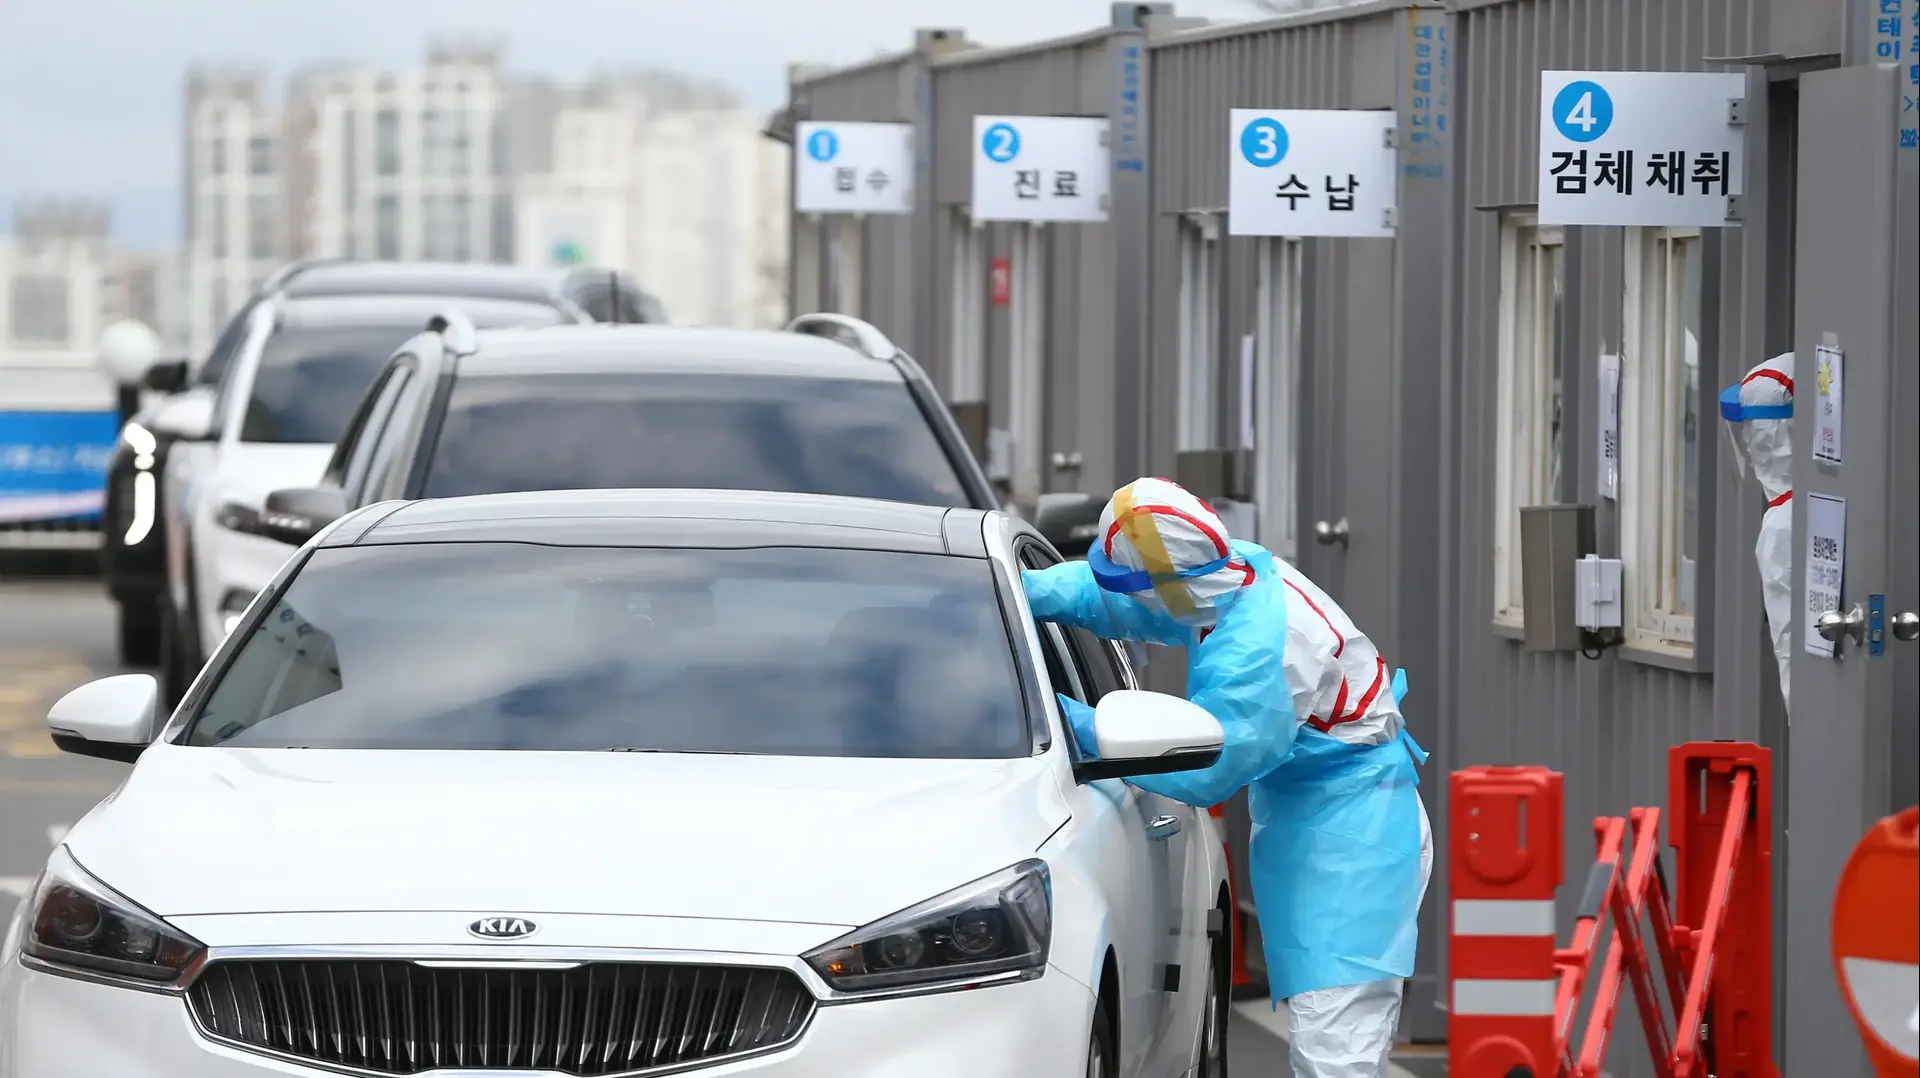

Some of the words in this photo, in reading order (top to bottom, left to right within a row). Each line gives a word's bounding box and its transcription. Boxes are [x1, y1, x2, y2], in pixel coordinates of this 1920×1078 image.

[1565, 91, 1597, 132] 4
[816, 134, 831, 158] 1
[992, 128, 1014, 157] 2
[1253, 125, 1278, 160] 3
[1014, 168, 1081, 199] 진료
[1550, 150, 1633, 195] 검체
[1646, 151, 1730, 196] 채취
[1276, 173, 1360, 211] 수납
[479, 918, 528, 934] KIA
